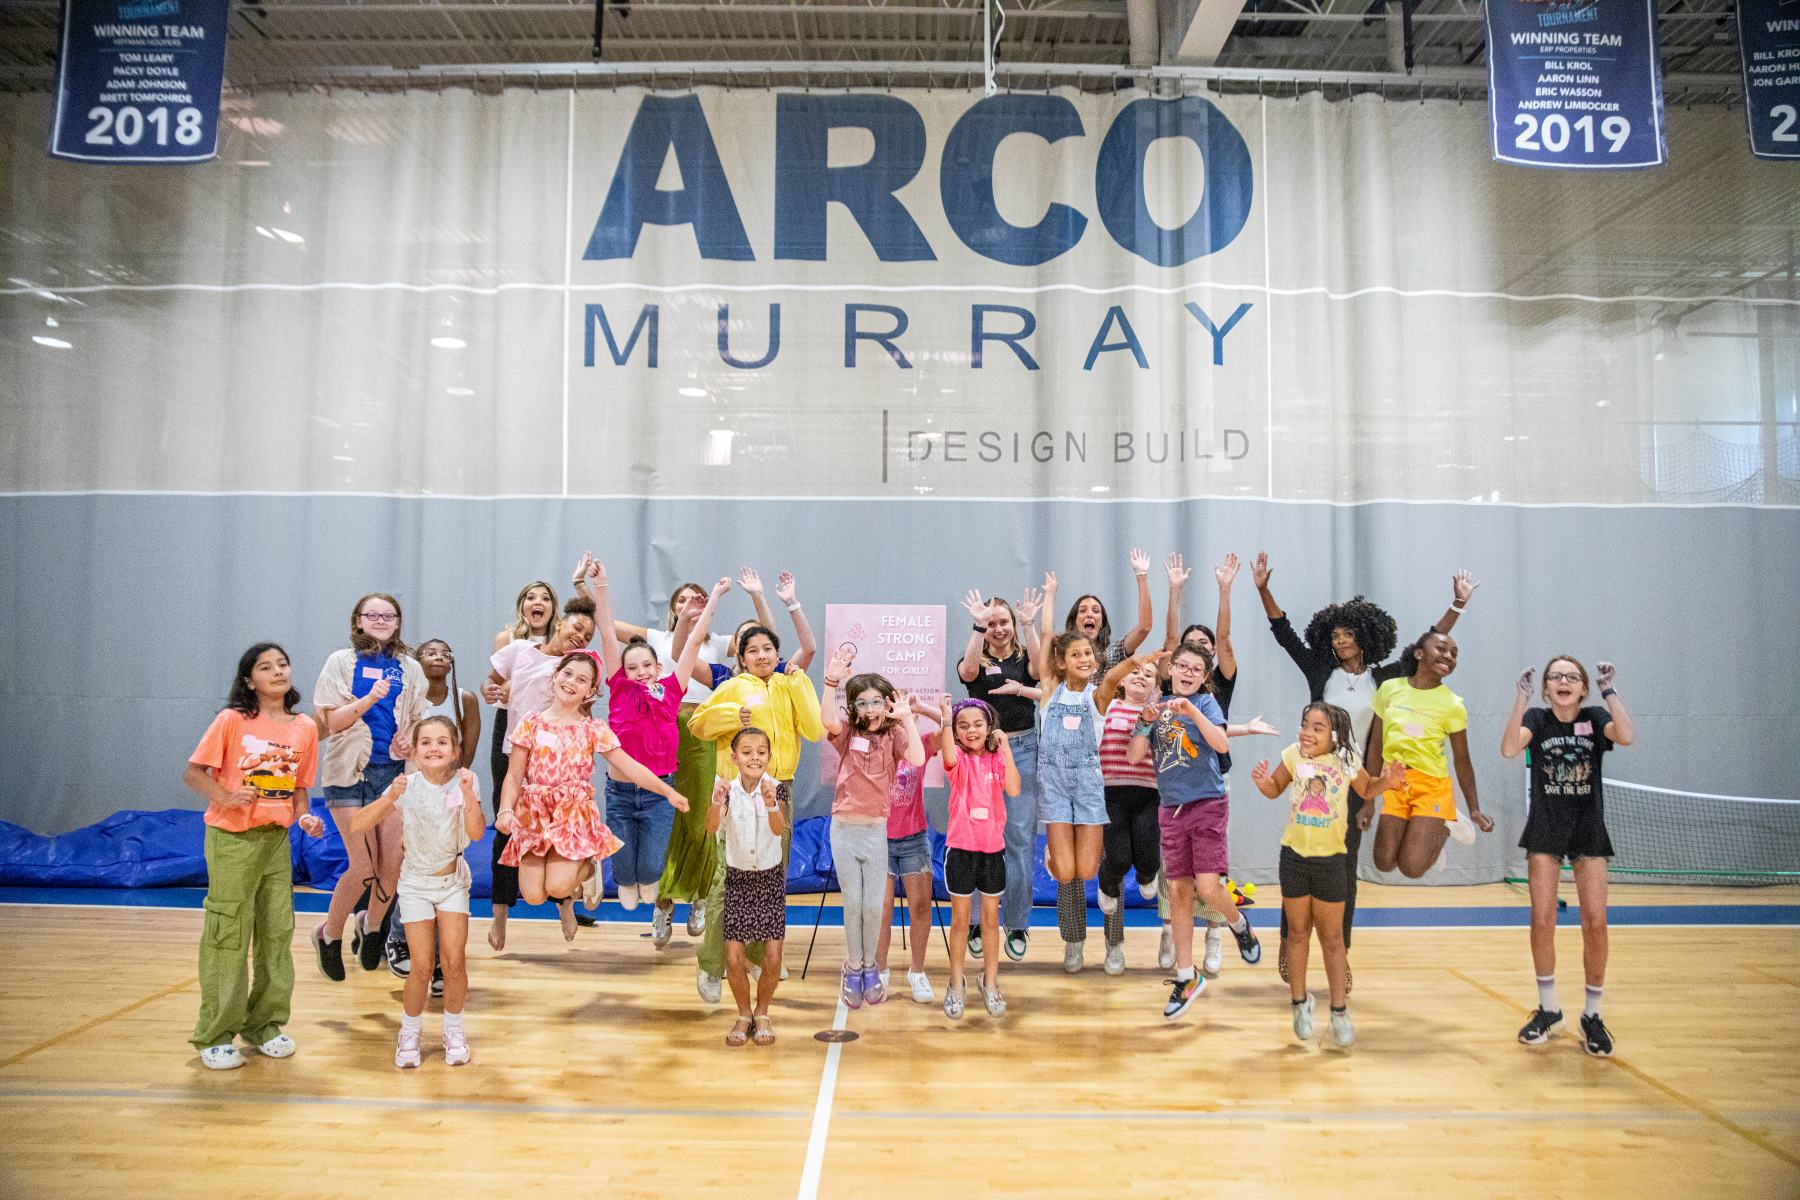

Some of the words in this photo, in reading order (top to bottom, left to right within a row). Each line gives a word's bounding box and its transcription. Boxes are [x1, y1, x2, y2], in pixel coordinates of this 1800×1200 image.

[1537, 8, 1599, 27] TOURNAMENT
[94, 25, 159, 37] WINNING
[162, 25, 204, 38] TEAM
[1511, 32, 1579, 45] WINNING
[1583, 34, 1622, 46] TEAM
[1555, 46, 1597, 54] PROPERTIES
[1753, 52, 1775, 60] BILL
[119, 54, 141, 63] TOM
[143, 54, 174, 63] LEARY
[113, 66, 143, 76] PACKY
[146, 67, 179, 76] DOYLE
[1545, 61, 1565, 70] BILL
[1566, 61, 1592, 70] KROL
[1749, 63, 1786, 73] AARON
[106, 80, 135, 89] ADAM
[137, 80, 187, 90] JOHNSON
[1538, 74, 1574, 83] AARON
[1576, 75, 1599, 84] LINN
[1753, 78, 1773, 87] JON
[100, 92, 128, 102] BRETT
[1535, 87, 1558, 97] ERIC
[1559, 88, 1602, 98] WASSON
[1518, 100, 1562, 110] ANDREW
[1564, 101, 1620, 111] LIMBOCKER
[85, 106, 202, 145] 2018
[1770, 104, 1798, 142] 2
[1514, 113, 1631, 153] 2019
[582, 92, 1254, 268] ARCO
[583, 302, 1254, 371] MURRAY
[907, 430, 1087, 464] DESIGN
[1114, 429, 1250, 464] BUILD
[881, 615, 932, 628] FEMALE
[877, 632, 936, 645] STRONG
[886, 650, 926, 662] CAMP
[882, 666, 900, 674] FOR
[902, 666, 929, 675] GIRLS!
[1541, 736, 1565, 752] PROTECT
[1544, 784, 1561, 795] SAVE
[1562, 785, 1576, 796] THE
[1576, 784, 1592, 796] REEF
